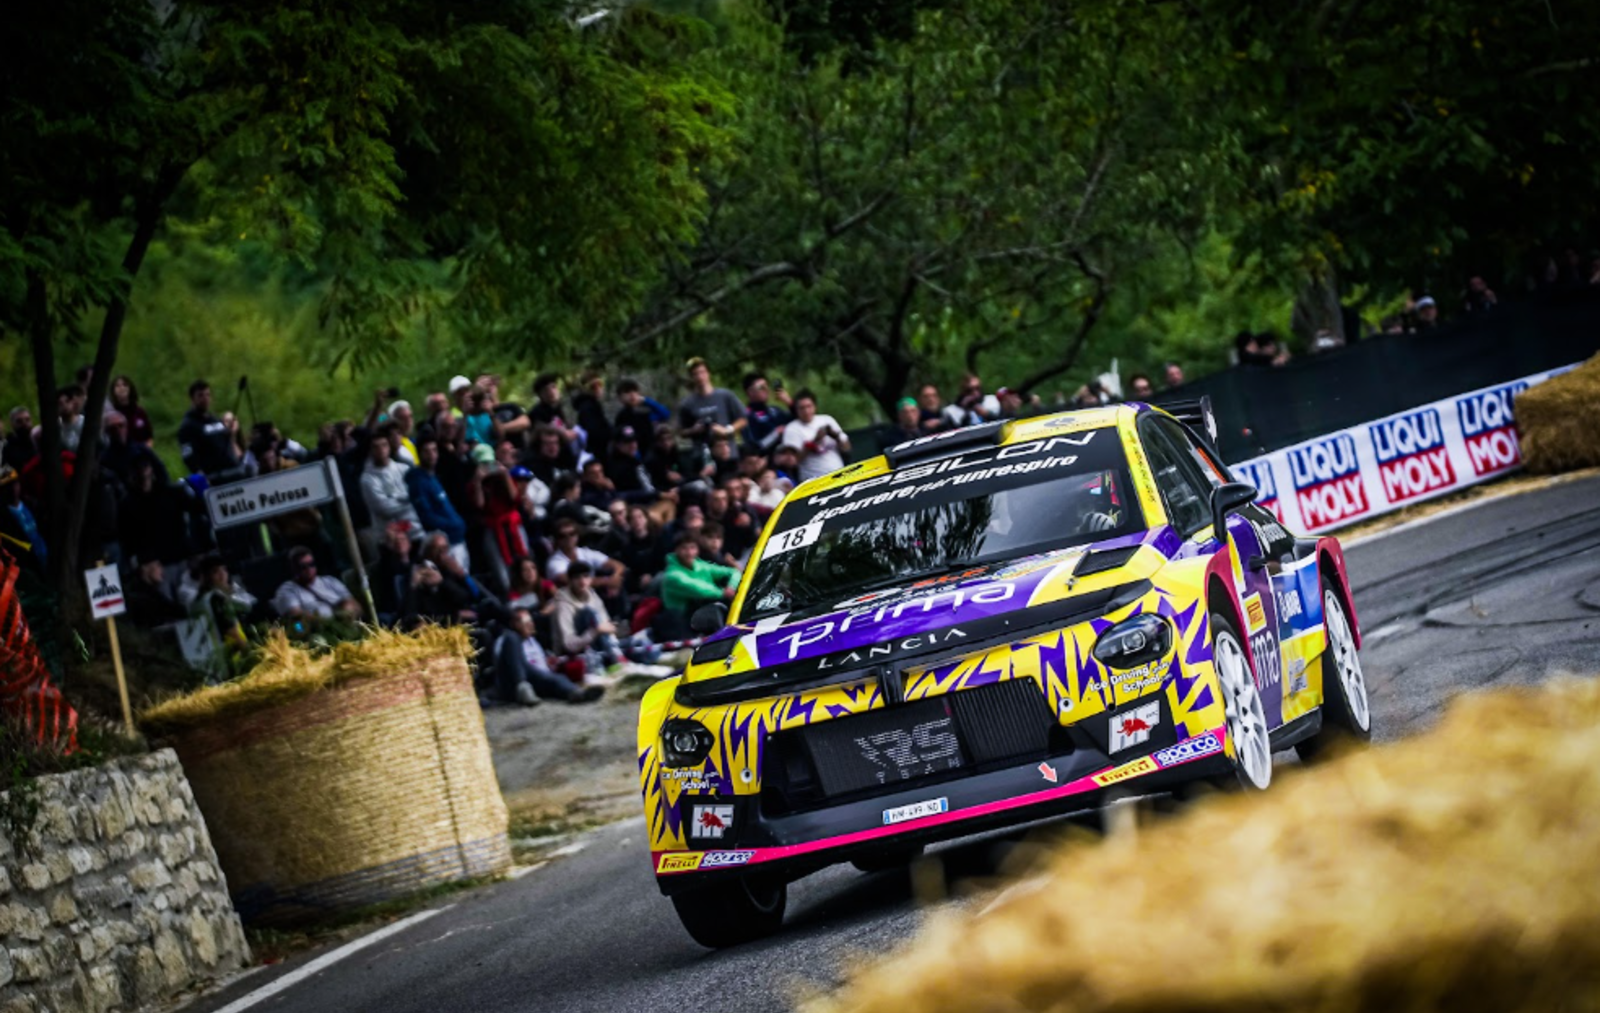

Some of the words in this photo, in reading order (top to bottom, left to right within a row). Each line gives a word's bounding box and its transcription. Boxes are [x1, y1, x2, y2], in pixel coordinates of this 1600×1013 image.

[1461, 385, 1525, 435] LIQU
[1373, 410, 1441, 461] LIQUI
[808, 431, 1096, 505] YPSILON
[1289, 436, 1357, 487] LIQUI
[1382, 448, 1451, 500] MOLY
[219, 499, 256, 518] Valle
[259, 487, 310, 508] Petrosa
[1299, 475, 1365, 527] MOLY
[782, 528, 806, 549] 18
[777, 581, 1016, 660] prima
[817, 628, 967, 670] LANCIA
[1089, 680, 1108, 692] Ice
[1110, 666, 1149, 685] Driving
[1100, 759, 1150, 783] PIRELLI
[1157, 735, 1222, 768] sparco
